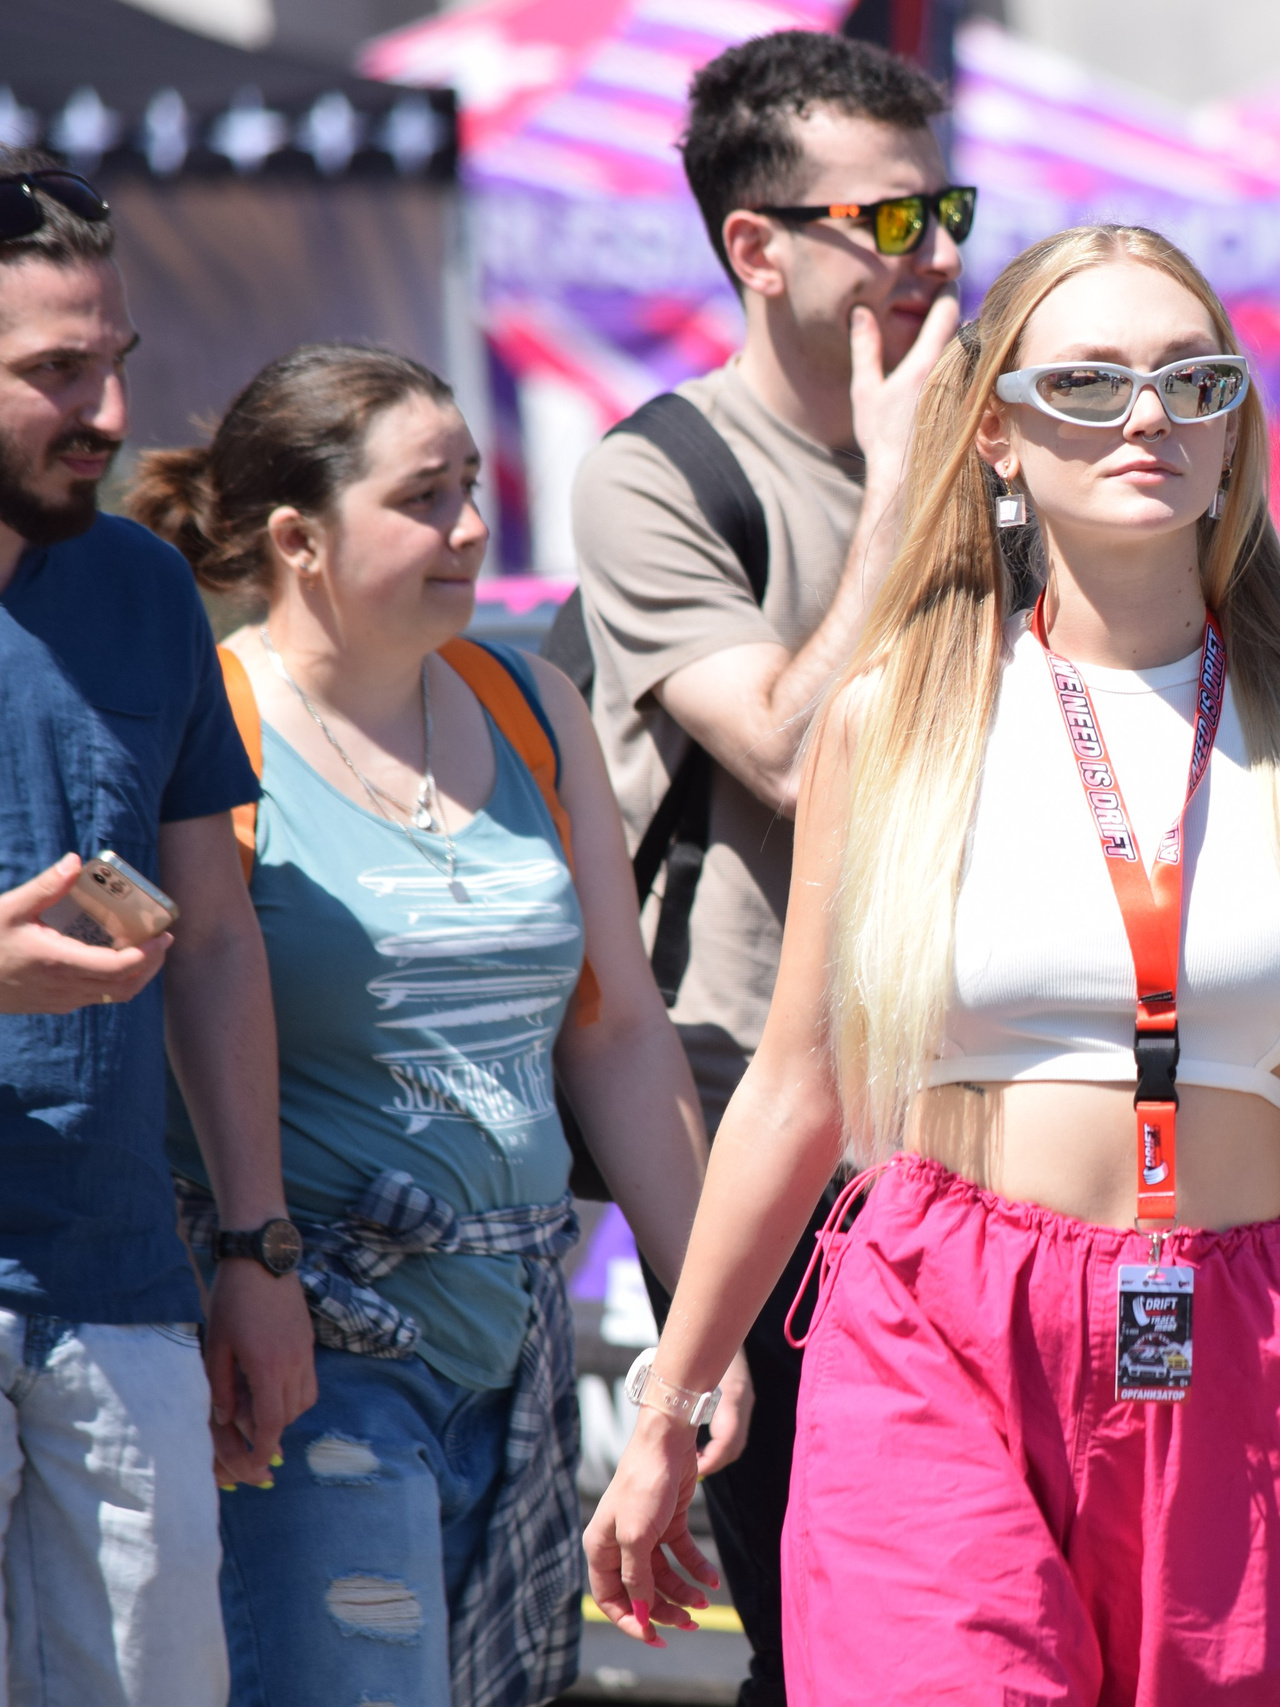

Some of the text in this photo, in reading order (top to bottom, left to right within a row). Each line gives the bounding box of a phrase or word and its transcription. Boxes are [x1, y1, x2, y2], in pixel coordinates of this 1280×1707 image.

[1202, 622, 1227, 702] DRIFT
[1200, 688, 1219, 728] IS
[1049, 654, 1138, 863] WE NEED IS DRIFT
[1145, 1296, 1178, 1311] DRIFT
[1120, 1388, 1185, 1401] ОРГАНИЗАТОР
